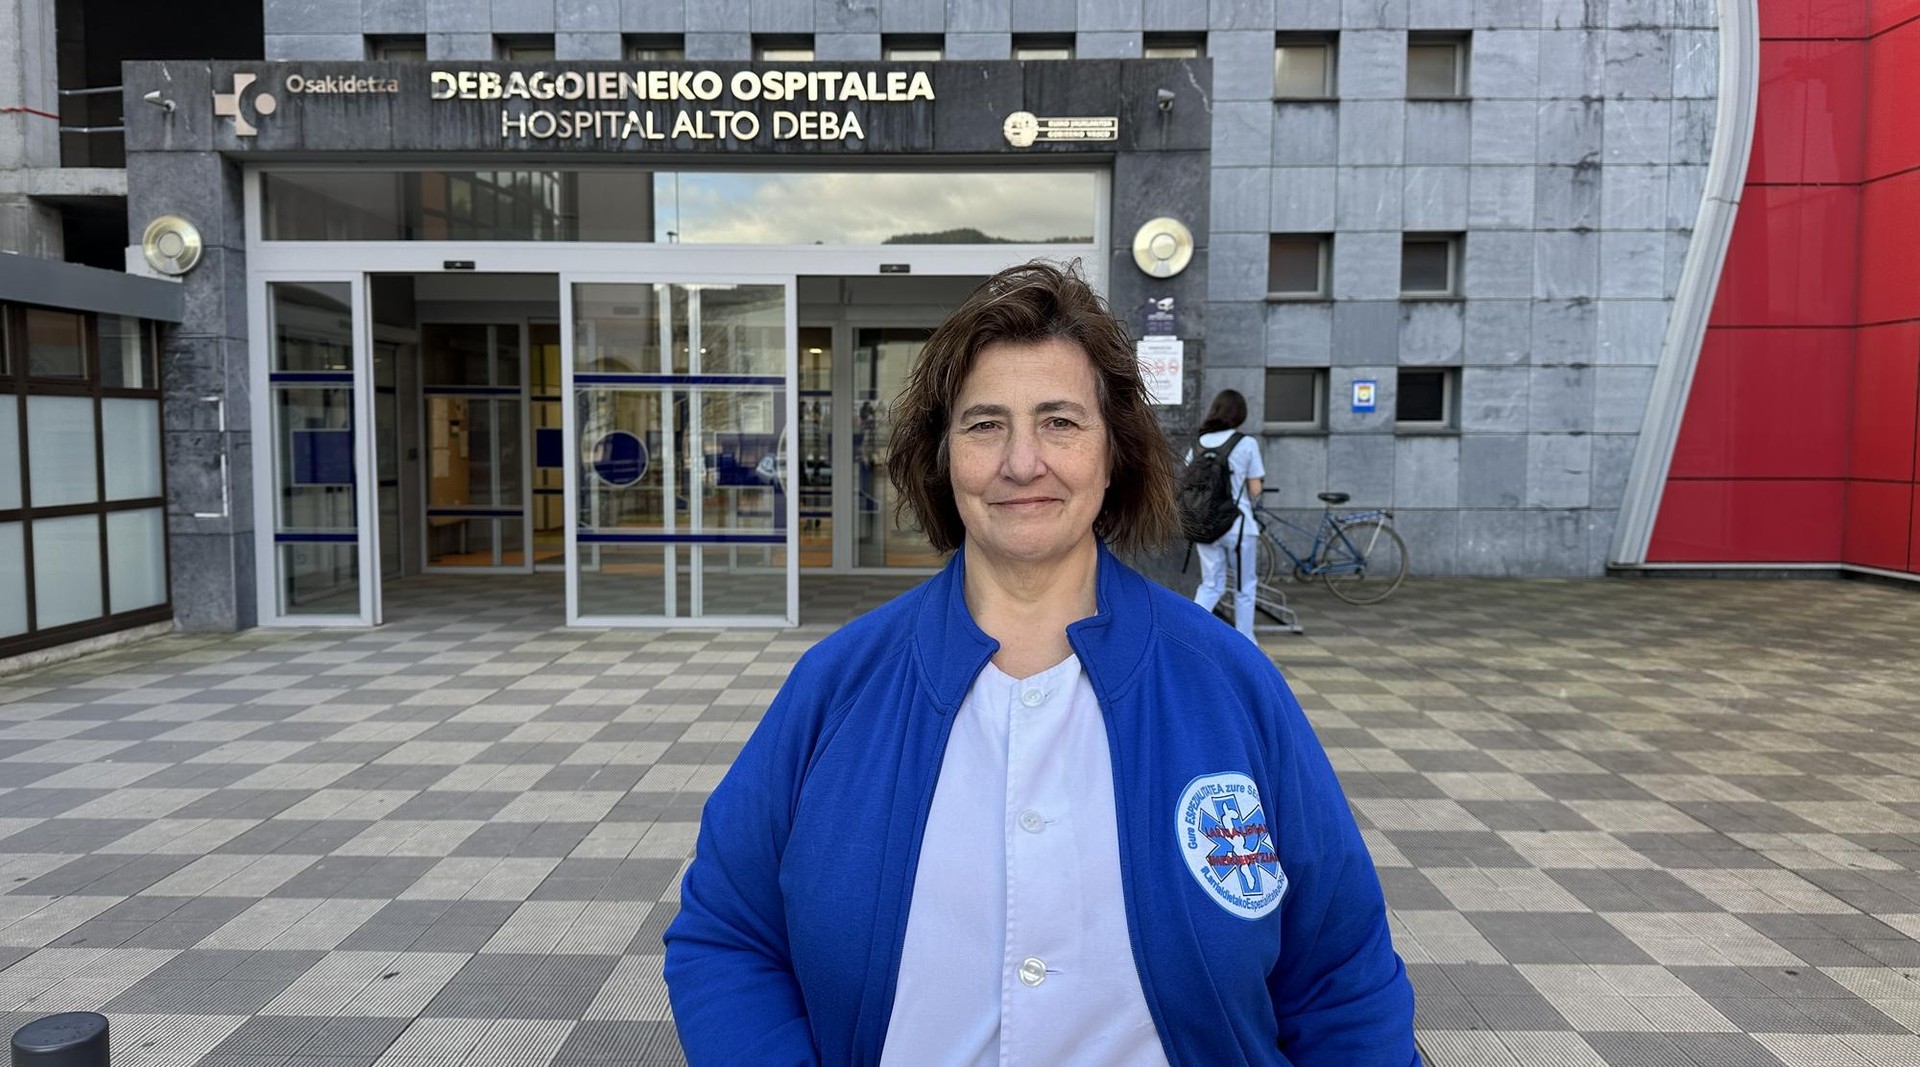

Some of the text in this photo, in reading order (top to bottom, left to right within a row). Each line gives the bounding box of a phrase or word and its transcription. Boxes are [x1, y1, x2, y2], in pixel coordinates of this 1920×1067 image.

[286, 74, 400, 95] Osakidetza
[430, 70, 935, 101] DEBAGOIENEKO OSPITALEA
[501, 109, 865, 141] HOSPITAL ALTO DEBA
[1187, 827, 1198, 850] Gure
[1225, 784, 1246, 794] zure
